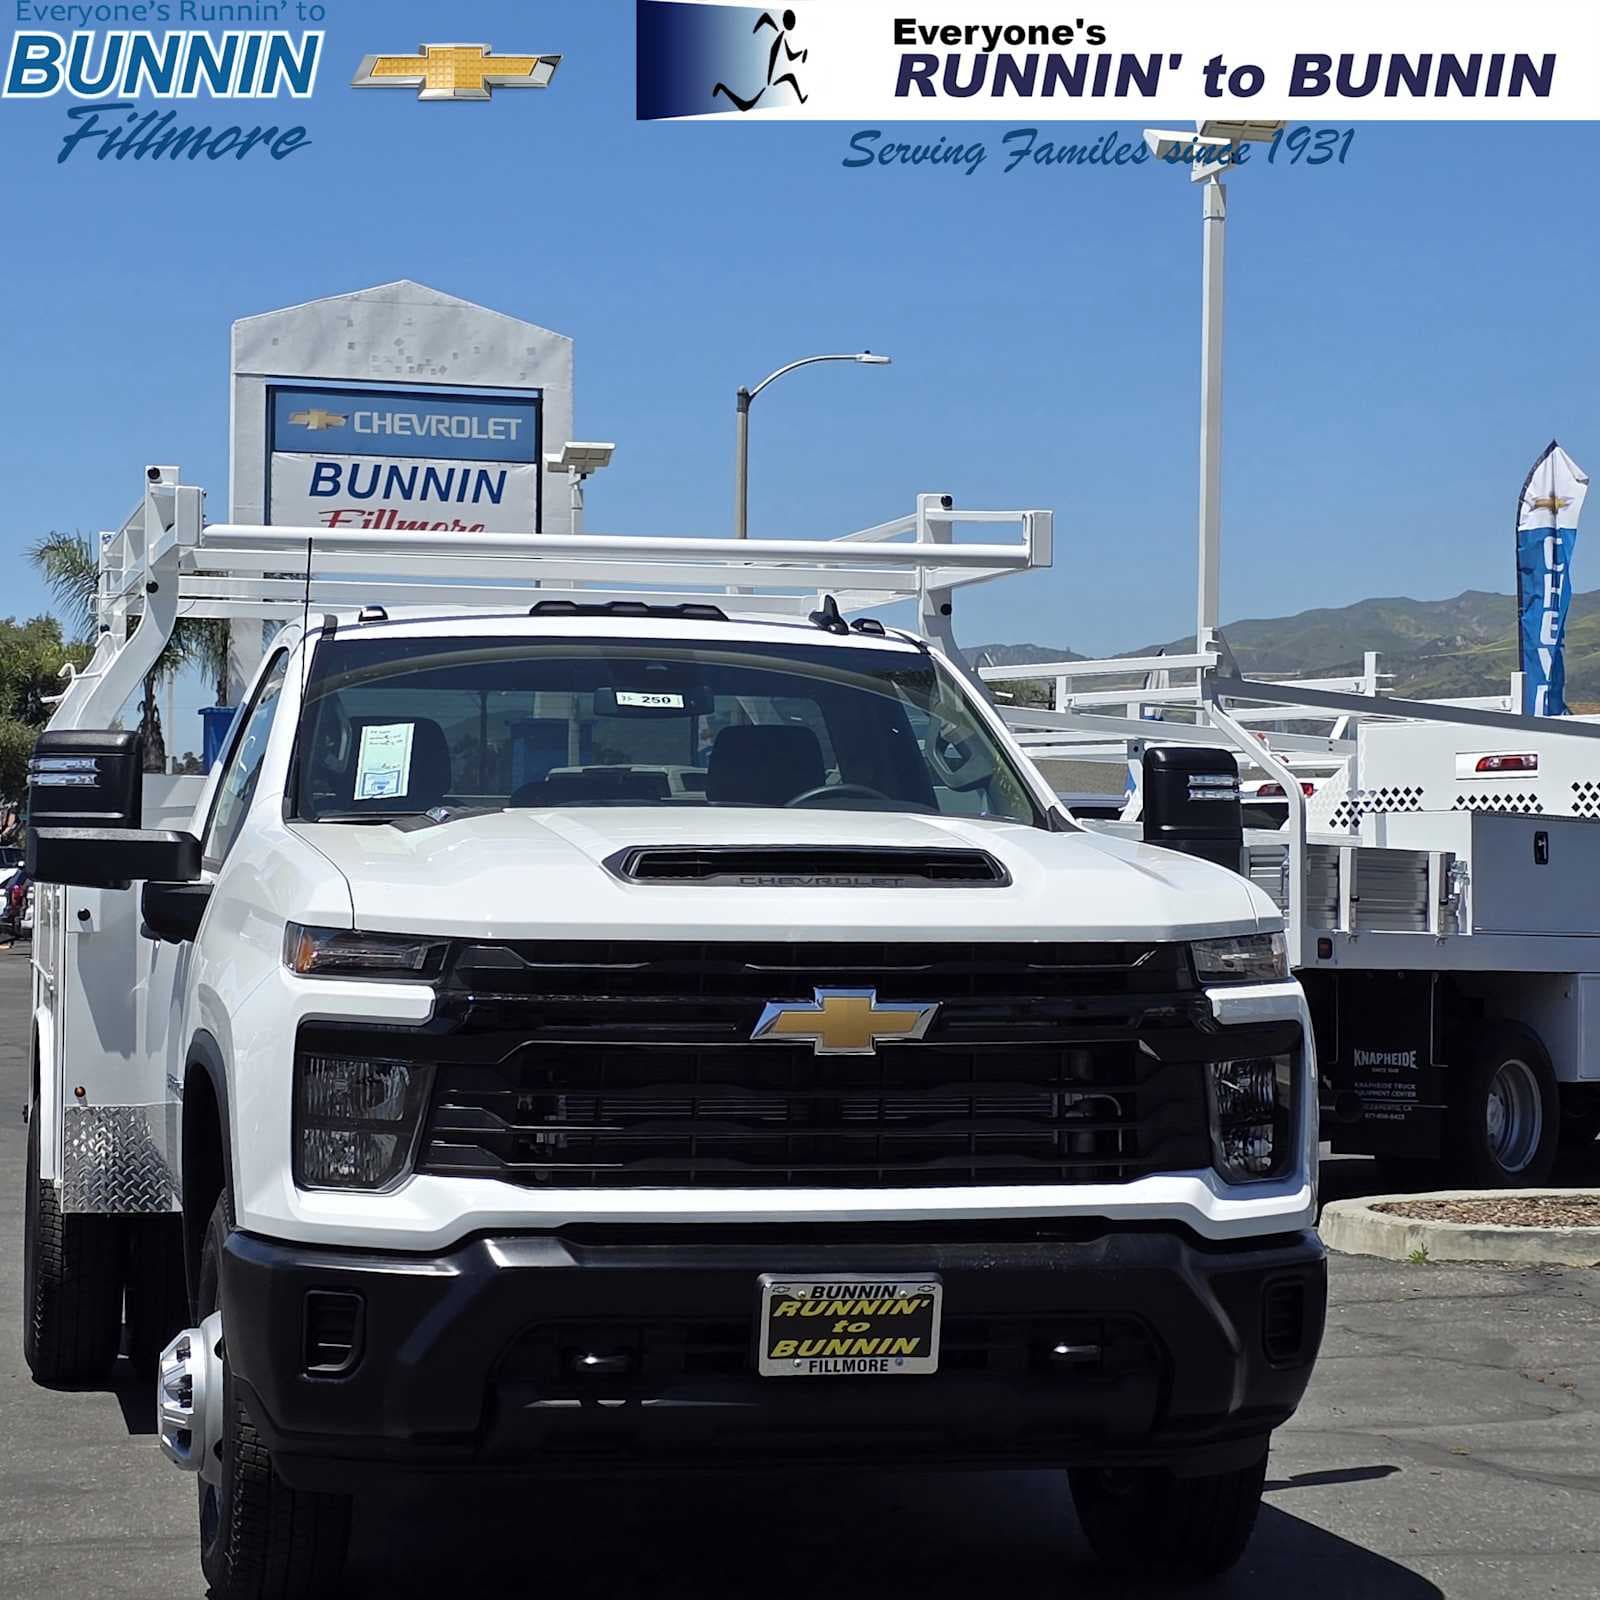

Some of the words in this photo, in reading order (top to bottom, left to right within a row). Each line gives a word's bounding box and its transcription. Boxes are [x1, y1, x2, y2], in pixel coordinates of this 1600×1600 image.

[353, 410, 522, 441] CHEVROLET
[309, 461, 507, 505] BUNNIN
[641, 695, 672, 705] 250
[739, 876, 905, 887] CHEVROLET
[1353, 1048, 1417, 1069] KNAPHEIDE
[811, 1285, 898, 1299] BUNNIN
[772, 1299, 931, 1317] RUNNIN'
[832, 1319, 871, 1333] to
[770, 1337, 921, 1357] BUNNIN
[808, 1359, 889, 1373] FILLMORE
